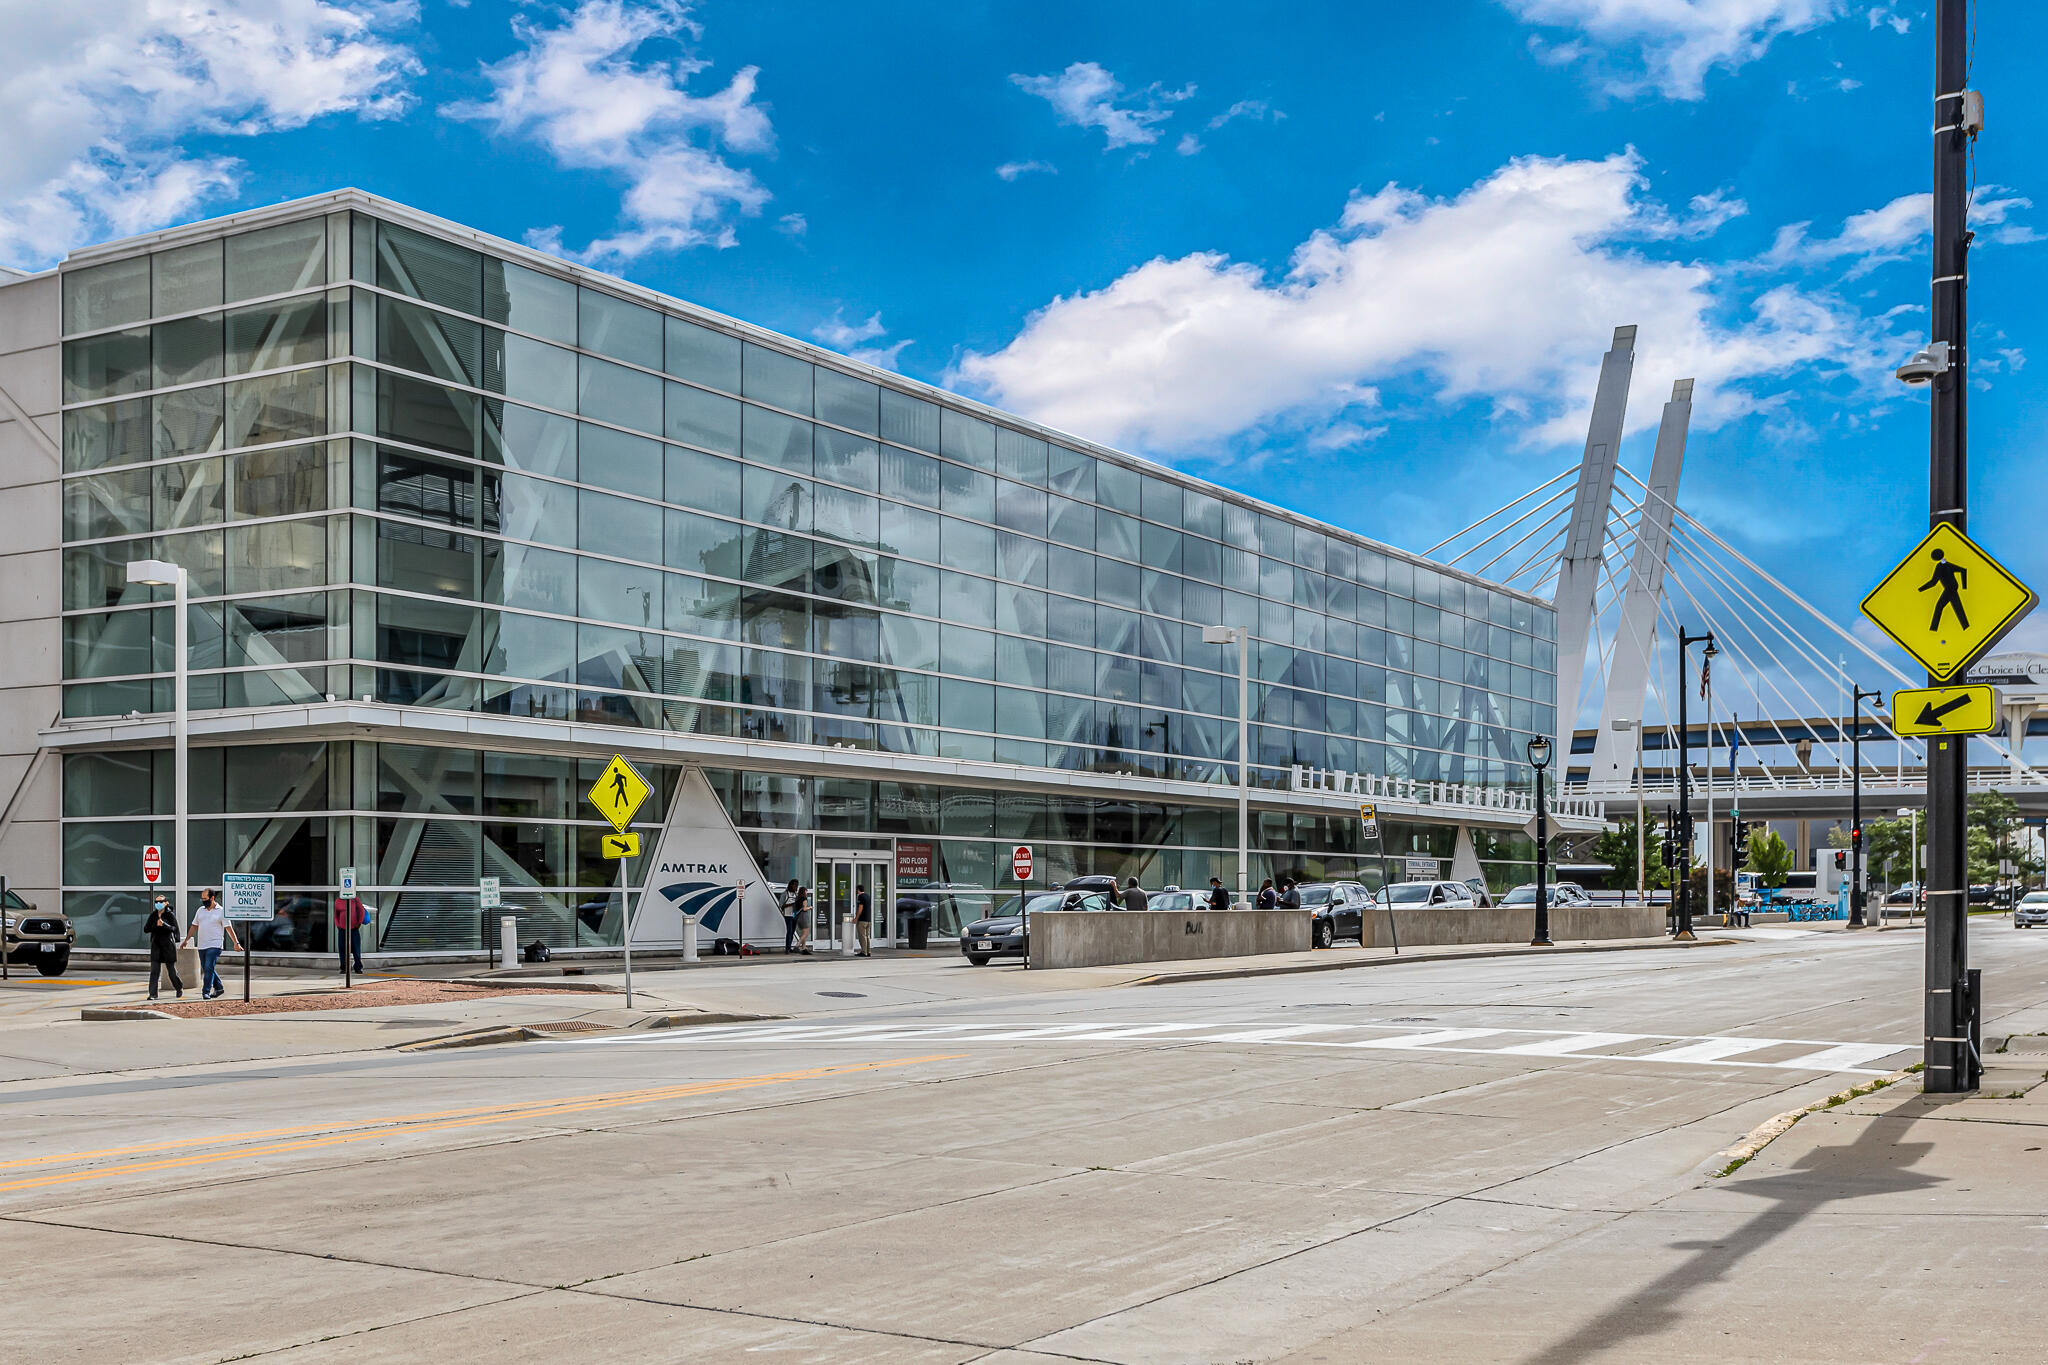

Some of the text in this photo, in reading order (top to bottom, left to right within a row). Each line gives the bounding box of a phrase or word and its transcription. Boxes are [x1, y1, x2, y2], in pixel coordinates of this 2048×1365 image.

[1978, 664, 2014, 675] Choice
[2016, 664, 2024, 674] is
[1291, 764, 1416, 801] MILWAUKEE
[899, 857, 928, 865] 2ND FLOOR
[660, 863, 728, 873] AMTRAK
[899, 866, 928, 875] AVAILABLE
